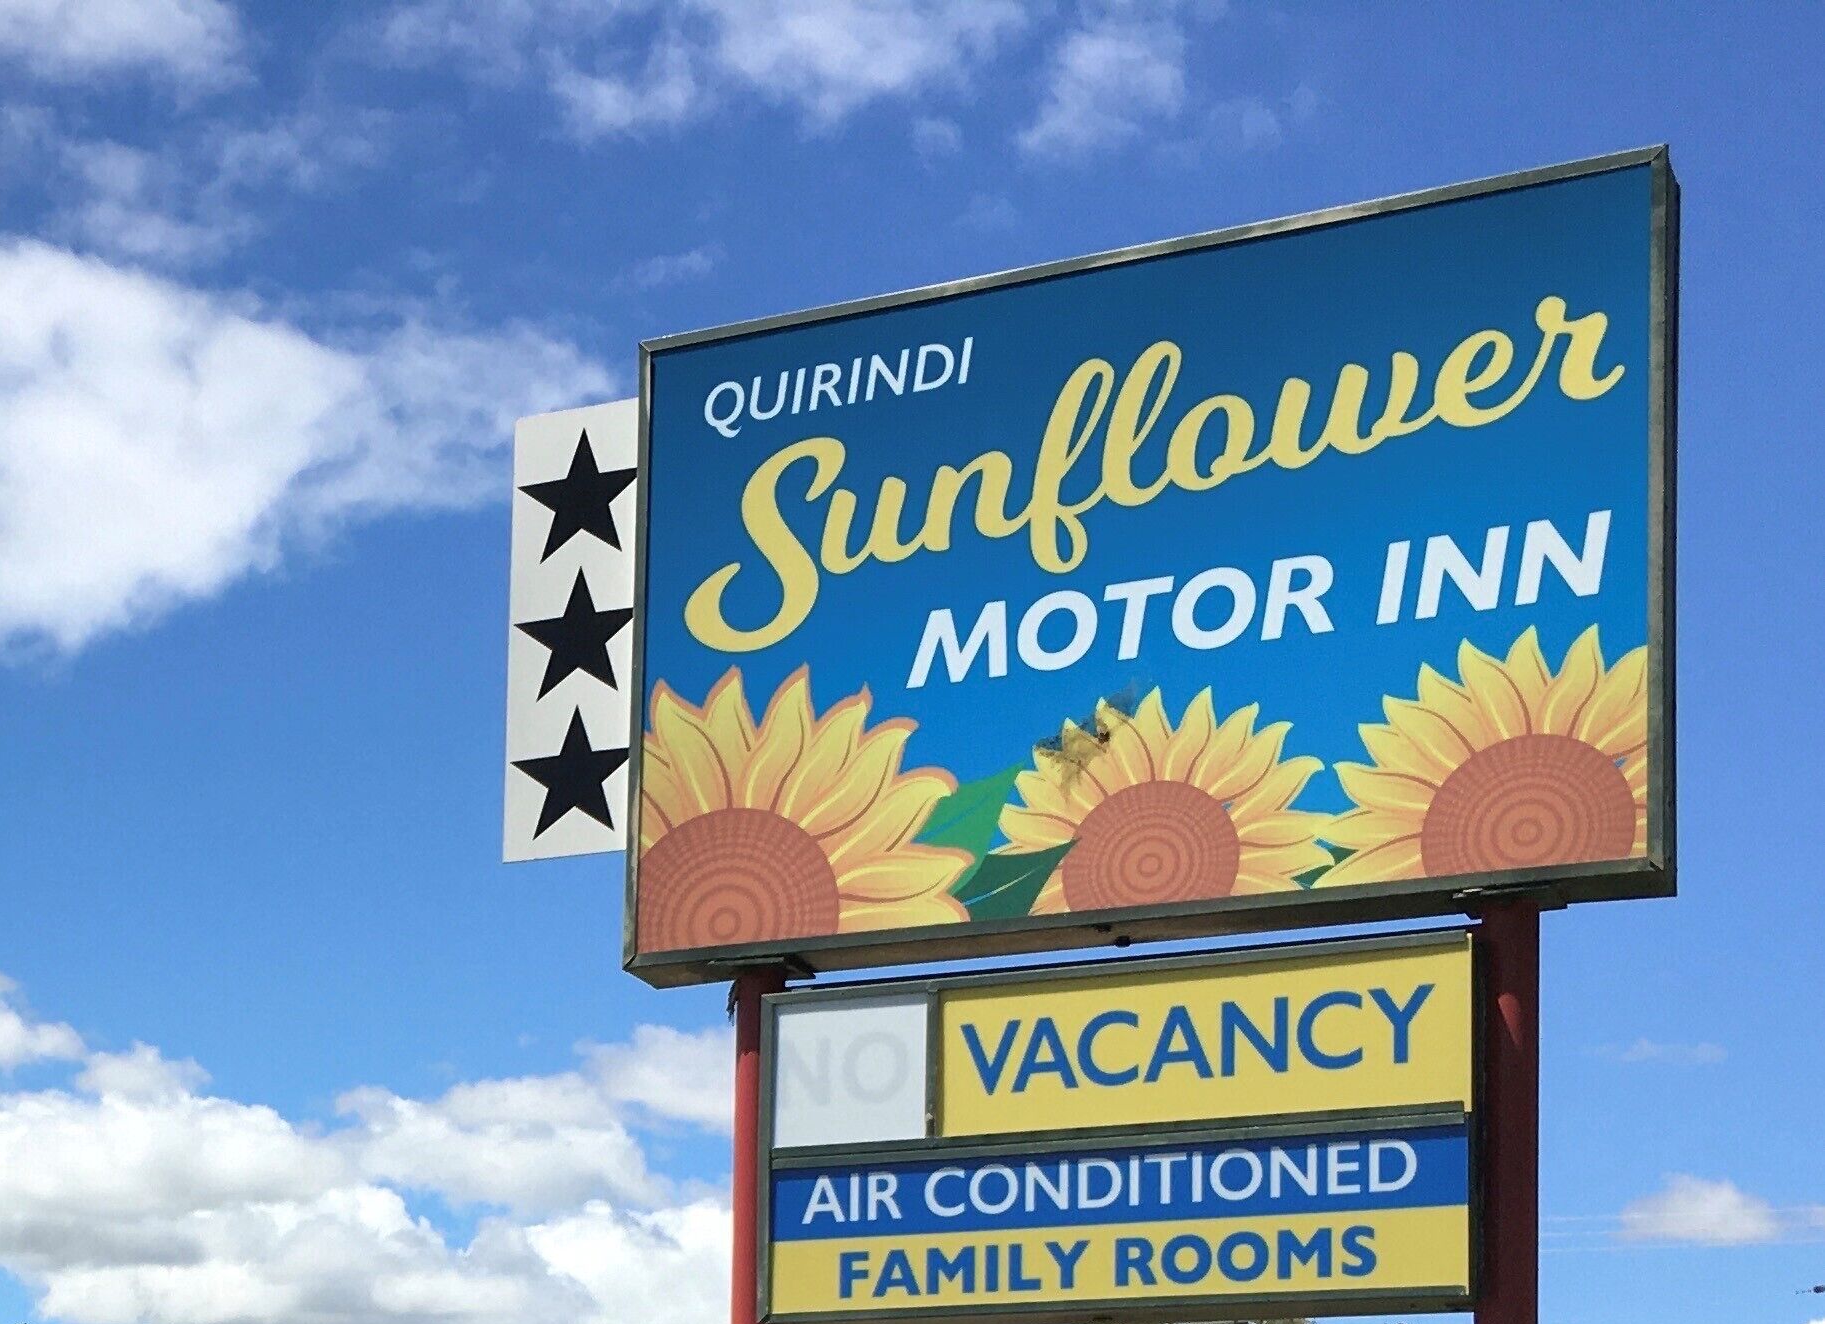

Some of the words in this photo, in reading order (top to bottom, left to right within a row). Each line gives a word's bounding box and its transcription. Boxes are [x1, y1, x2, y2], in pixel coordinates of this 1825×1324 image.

[703, 336, 974, 439] QUIRINDI
[683, 294, 1625, 653] Sunflower
[906, 553, 1335, 690] MOTOR
[1375, 509, 1615, 626] INN
[961, 983, 1436, 1096] VACANCY
[802, 1171, 902, 1225] AIR
[925, 1140, 1418, 1218] CONDITIONED
[838, 1239, 1091, 1299] FAMILY
[1114, 1226, 1377, 1287] ROOMS
